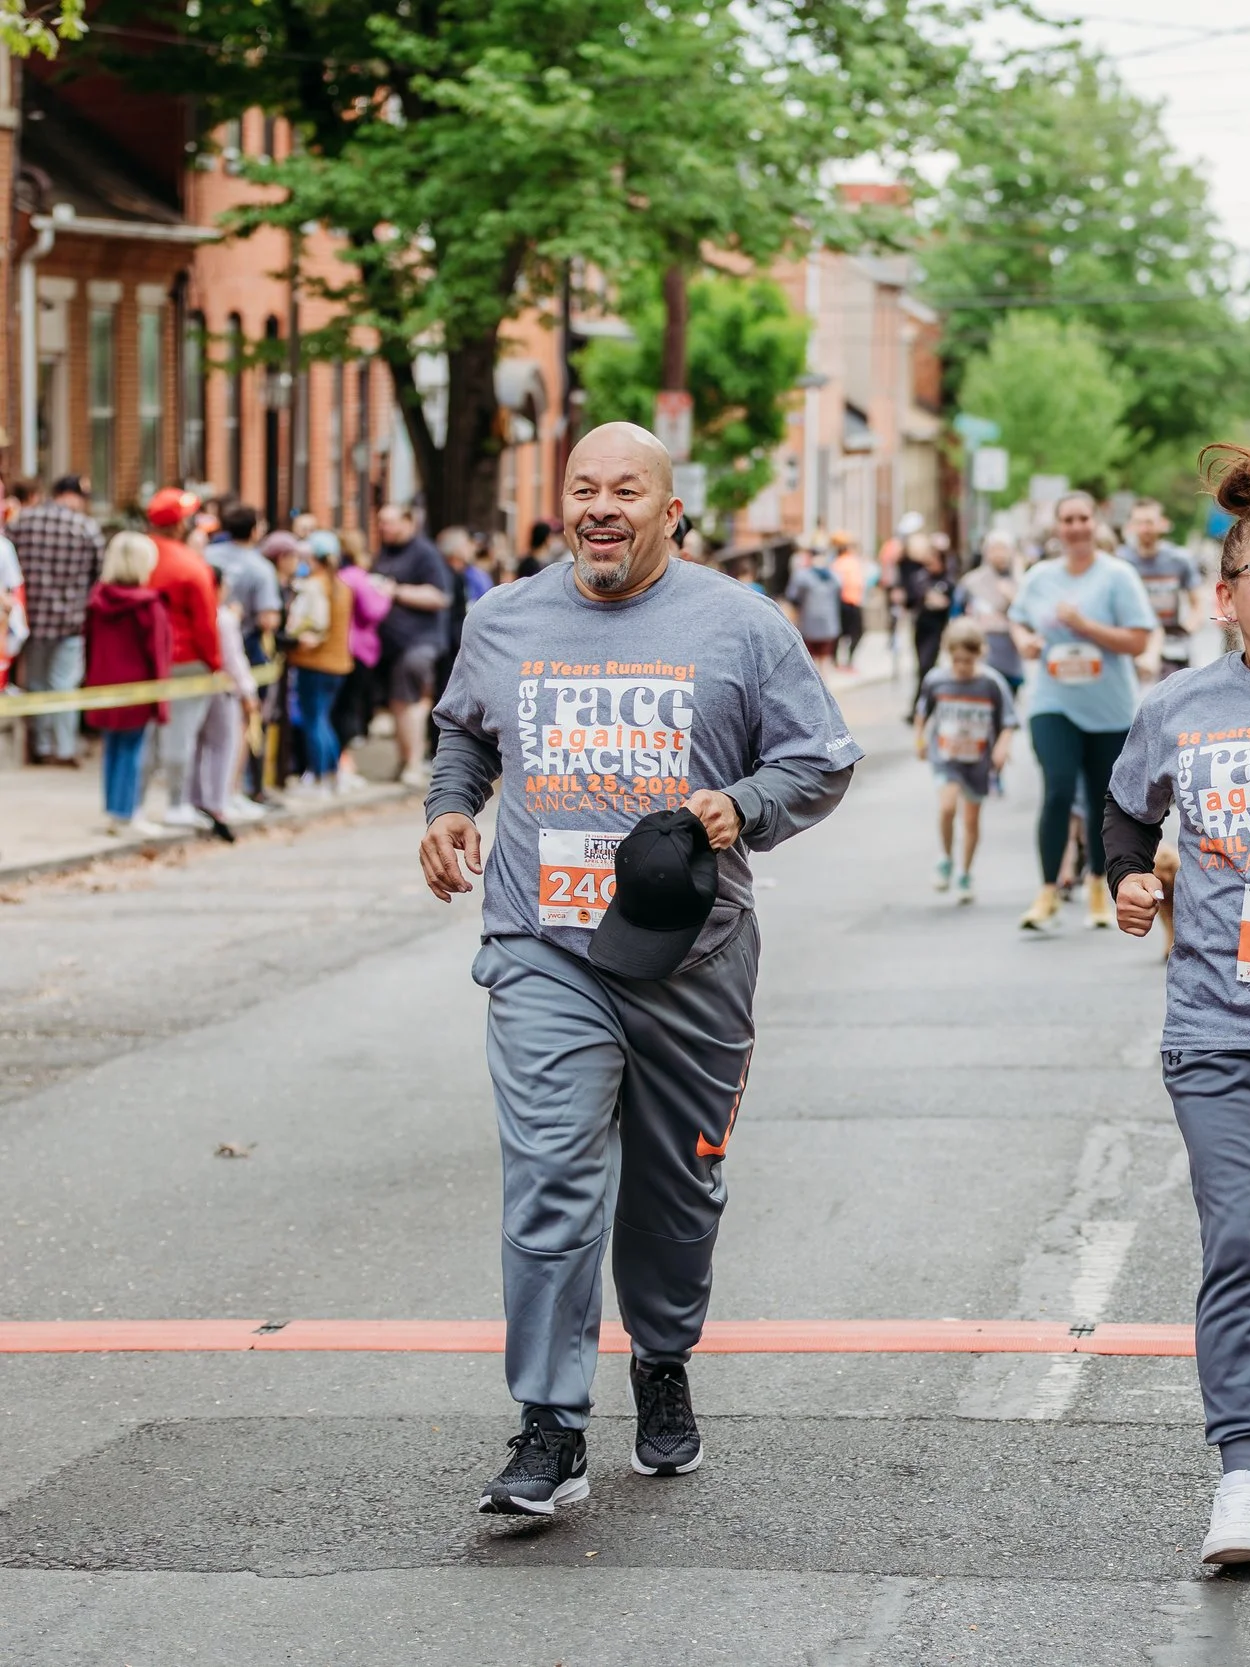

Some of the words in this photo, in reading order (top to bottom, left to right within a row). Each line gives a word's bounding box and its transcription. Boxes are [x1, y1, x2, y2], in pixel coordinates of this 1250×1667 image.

[520, 660, 544, 676] 28
[550, 661, 601, 676] Years
[605, 658, 696, 681] Running!
[545, 682, 695, 731] race
[517, 679, 542, 772] ywca
[547, 725, 685, 753] against
[543, 748, 690, 777] RACISM
[525, 775, 582, 793] APRIL
[587, 774, 625, 795] 25,
[632, 776, 690, 795] 2026
